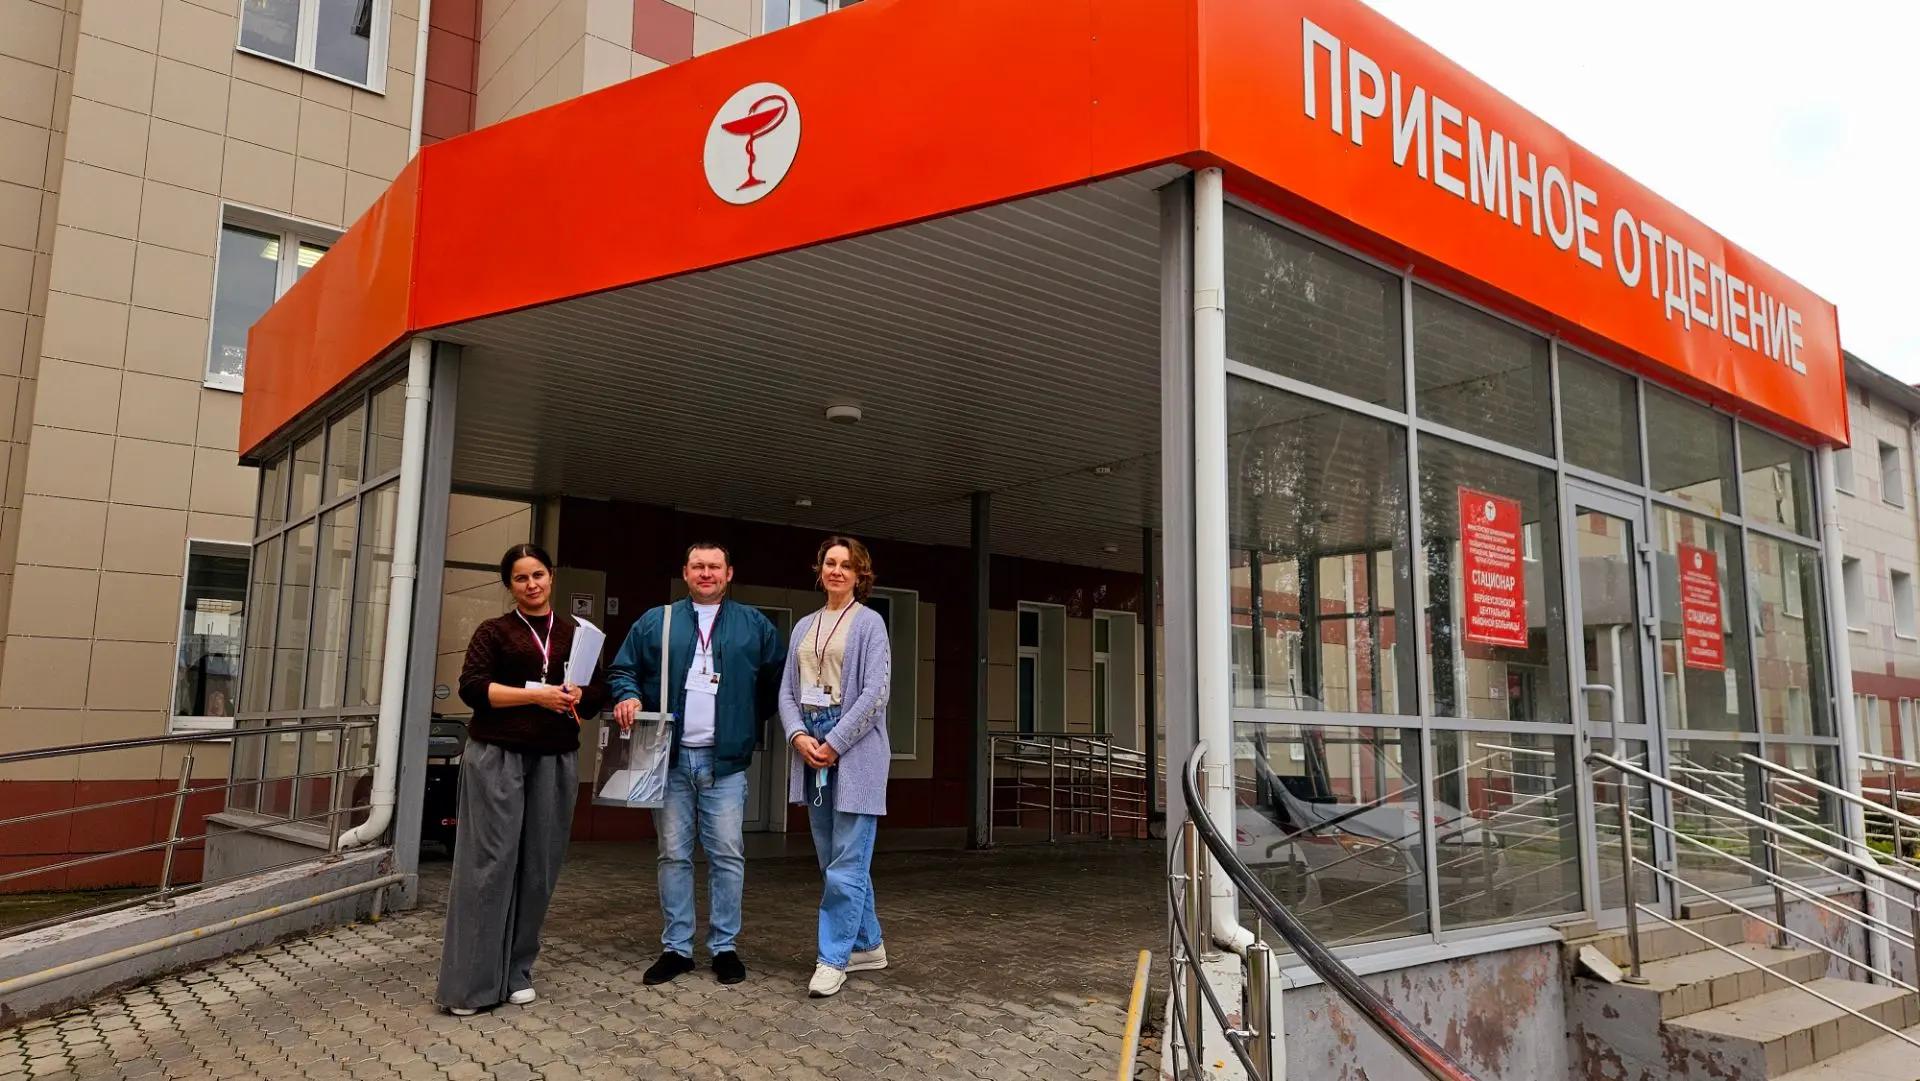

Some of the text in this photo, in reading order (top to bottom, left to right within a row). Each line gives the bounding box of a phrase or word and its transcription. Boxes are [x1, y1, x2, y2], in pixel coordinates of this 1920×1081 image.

[1302, 17, 1807, 375] ПРИЕМНОЕ ОТДЕЛЕНИЕ
[1472, 569, 1516, 591] СТАЦИОНАР
